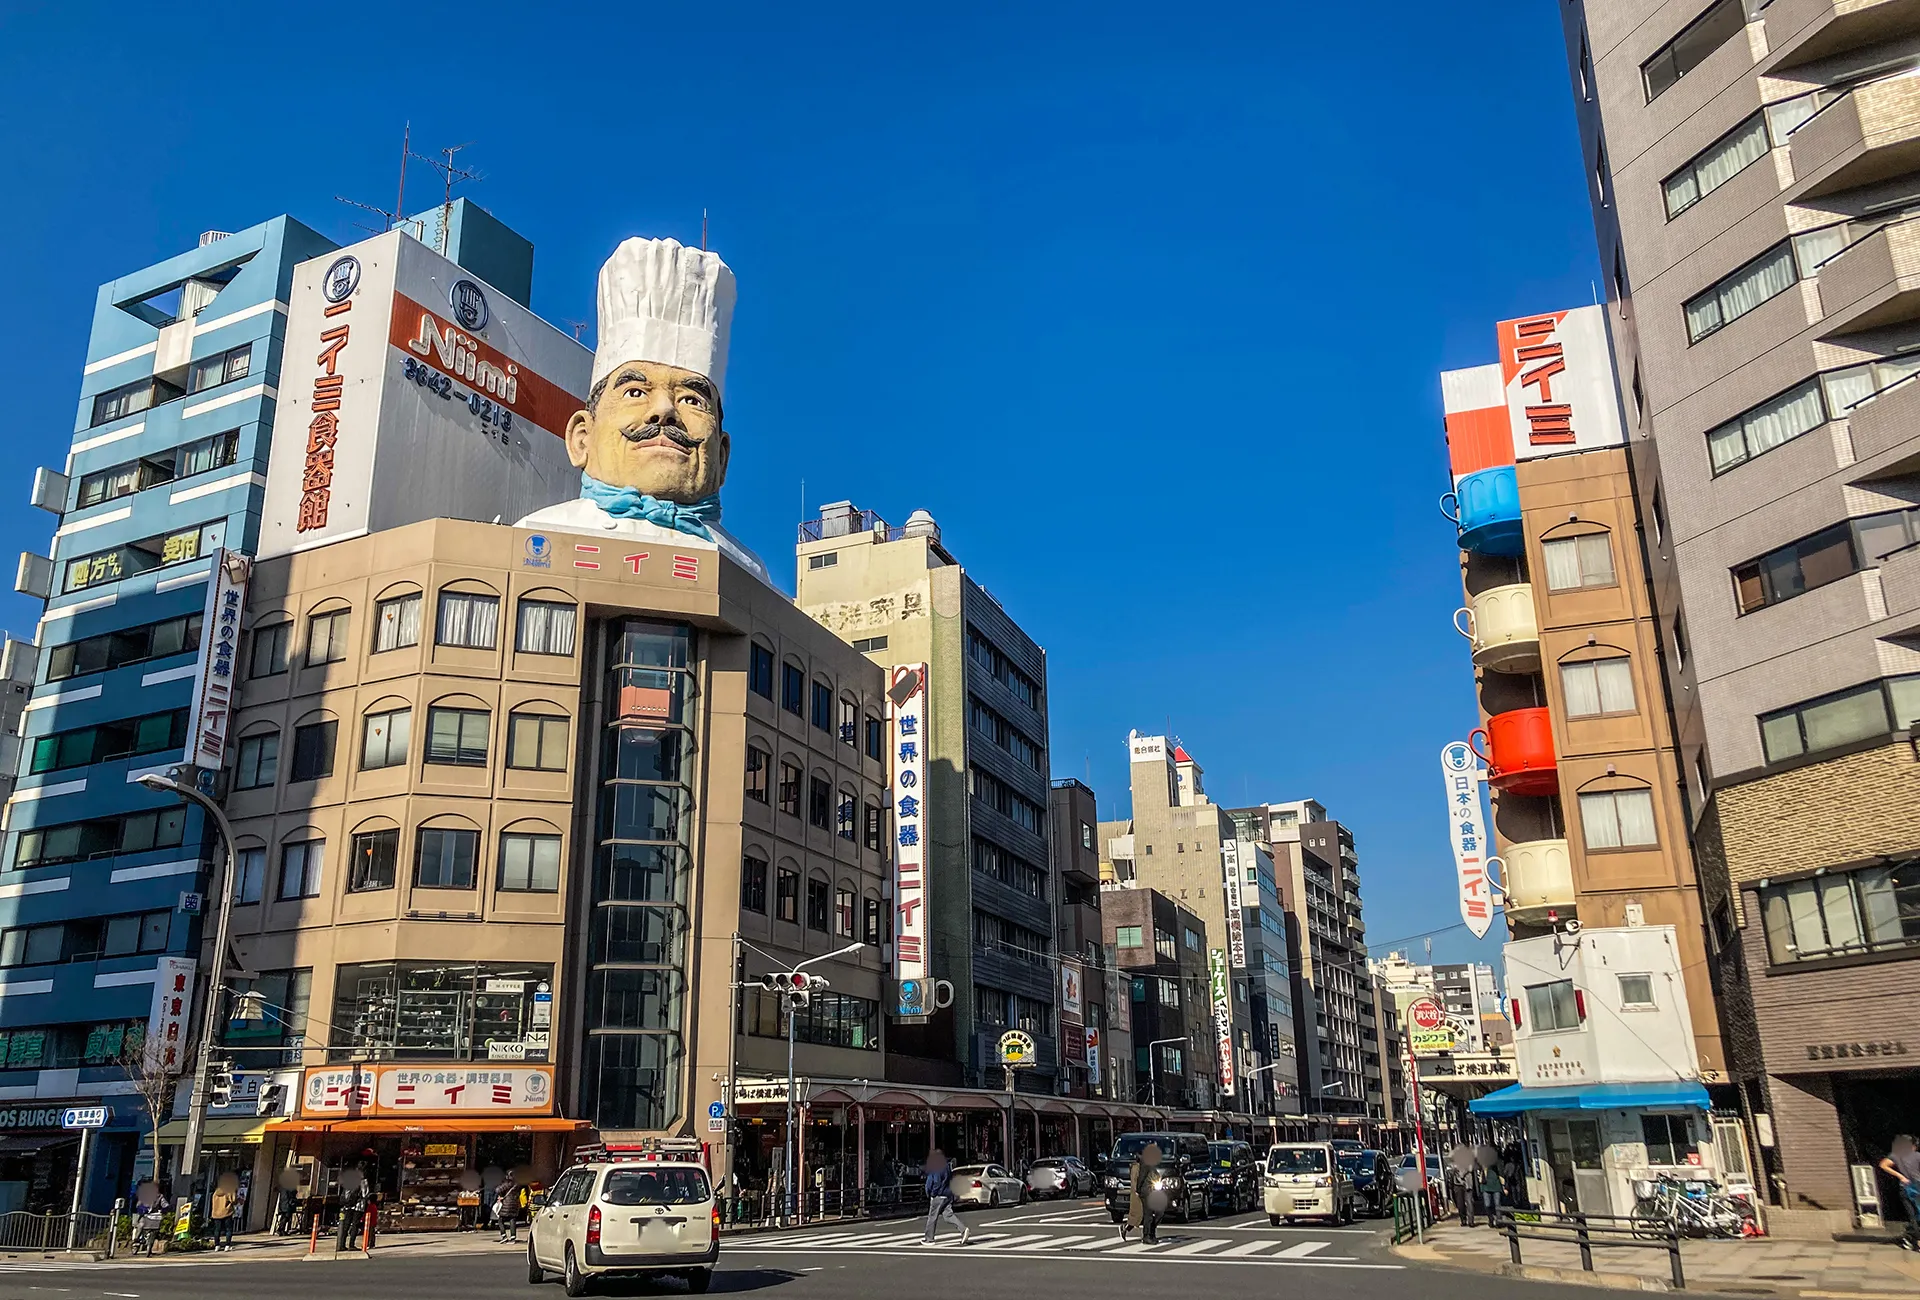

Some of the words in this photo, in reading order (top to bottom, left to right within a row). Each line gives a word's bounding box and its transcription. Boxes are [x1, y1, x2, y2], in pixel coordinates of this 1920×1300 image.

[408, 313, 518, 405] Niimi
[1517, 318, 1577, 447] ニイミ
[297, 300, 352, 534] ニイミ食器館
[162, 528, 200, 563] 受付
[573, 544, 699, 581] ニイミ
[212, 589, 240, 678] 世界の食器
[202, 682, 228, 757] ニイミ
[897, 714, 919, 847] 世界の食器
[1455, 776, 1477, 852] 日本の食器
[1462, 857, 1488, 919] ニイミ
[896, 862, 922, 963] ニイミ
[1210, 949, 1226, 996] ショーケース
[1415, 1010, 1439, 1021] 消火栓
[491, 1044, 524, 1053] NIKKO
[527, 1033, 547, 1042] N4
[1412, 1033, 1448, 1043] カジワラ
[324, 1085, 371, 1107] ニイミ
[395, 1084, 512, 1105] ニイミ
[397, 1072, 512, 1085] 世界の食器・調理器具
[18, 1108, 63, 1126] BURGE
